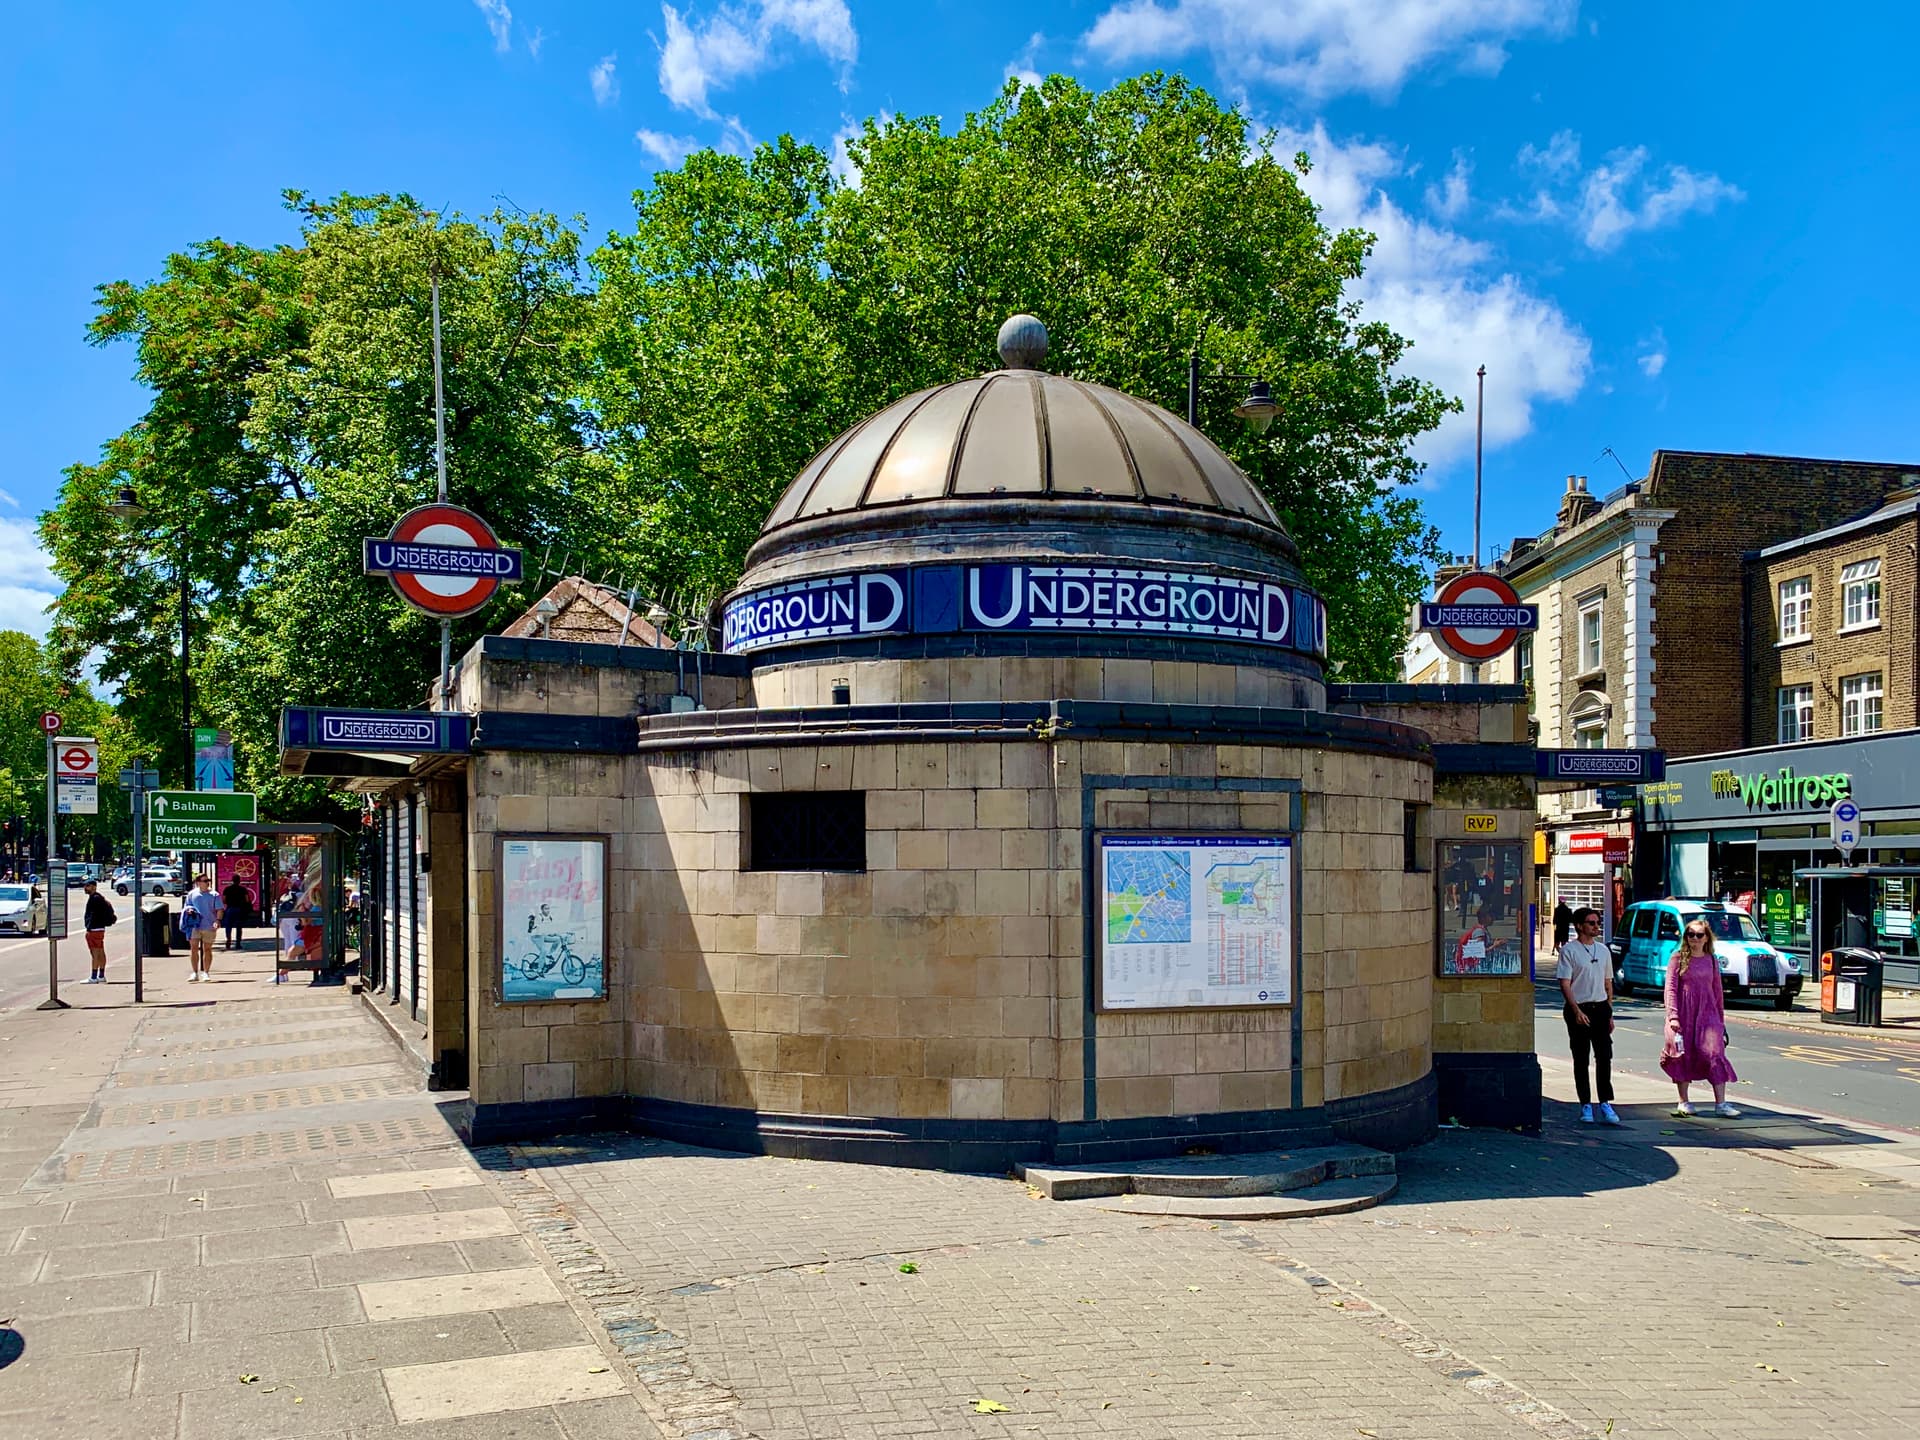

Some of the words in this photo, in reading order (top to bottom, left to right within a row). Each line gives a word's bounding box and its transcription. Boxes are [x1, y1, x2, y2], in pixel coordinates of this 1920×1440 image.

[375, 545, 514, 574] UNDERGROUND
[723, 573, 904, 648] NDERGROUND
[969, 567, 1290, 642] UNDERGROUND
[1426, 608, 1532, 626] UNDERGROUND
[46, 715, 60, 729] D
[328, 721, 431, 740] UNDERGROUND
[1561, 757, 1638, 772] UNDERGROUND
[1644, 784, 1658, 794] Open
[1658, 783, 1669, 793] daily
[1670, 781, 1683, 789] from
[1738, 766, 1849, 806] Waitrose
[172, 801, 216, 811] Balham
[1658, 793, 1665, 804] to
[1667, 792, 1683, 806] 11pm
[155, 824, 228, 835] Wandsworth
[1467, 817, 1495, 829] RVP
[155, 835, 213, 845] Battersea
